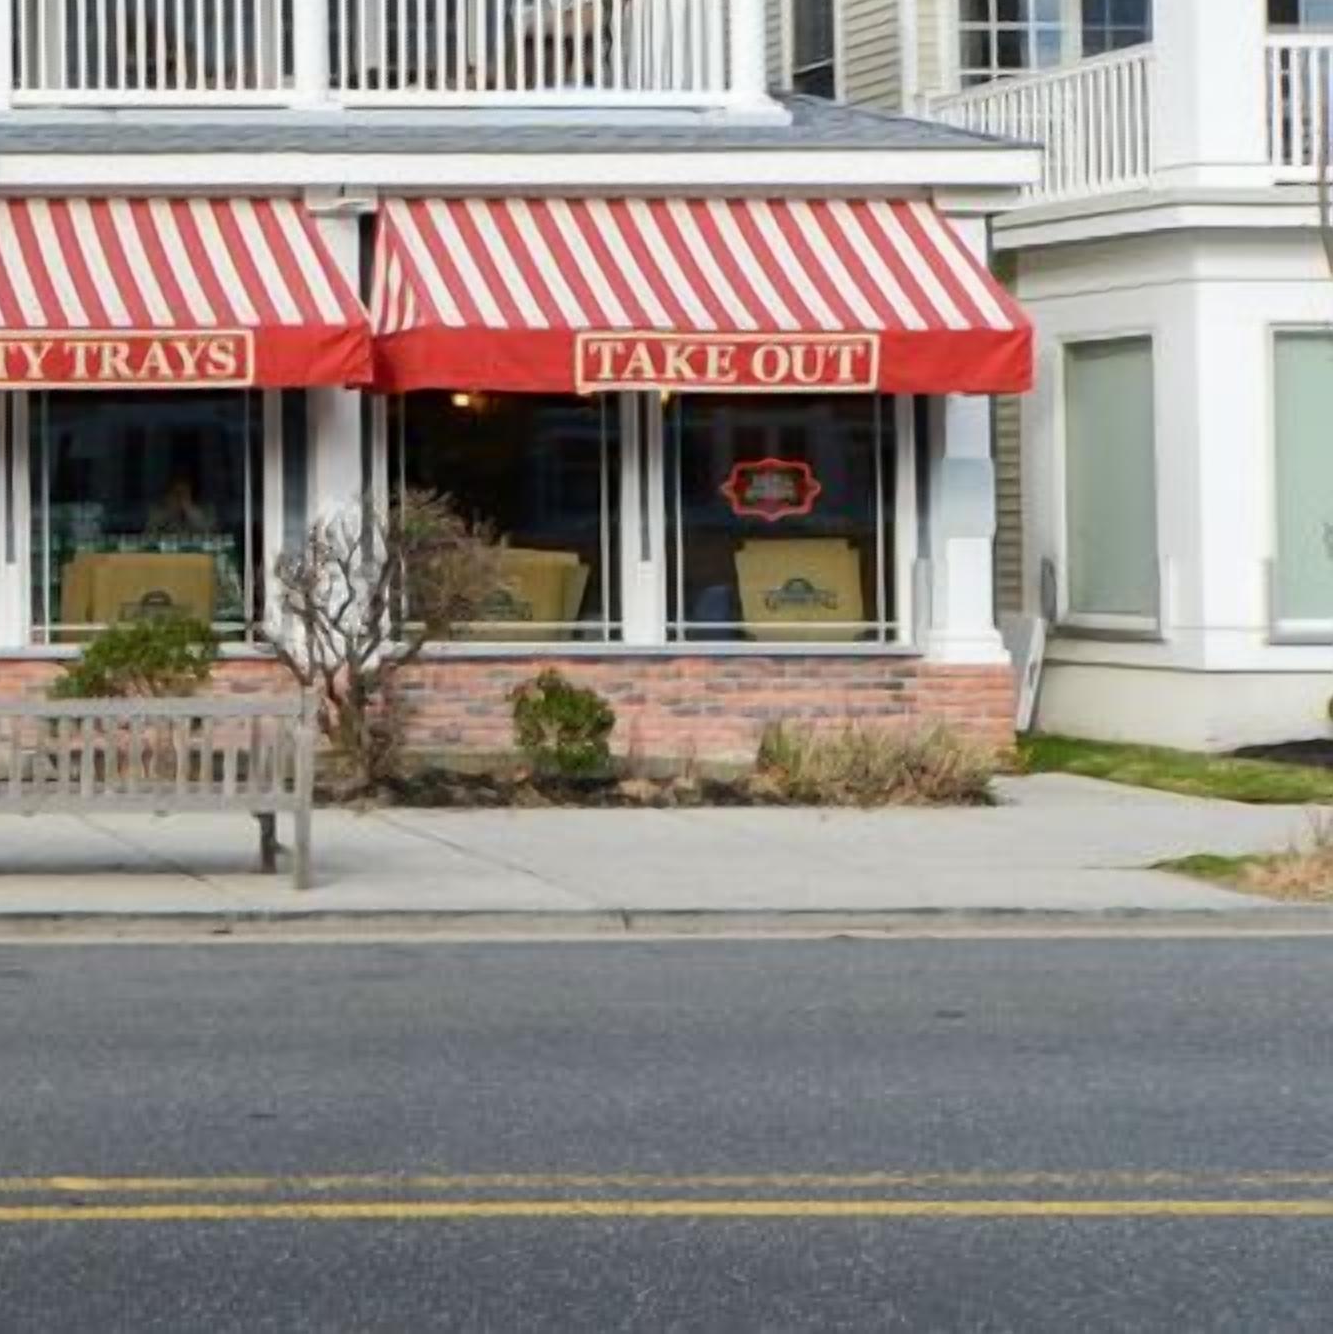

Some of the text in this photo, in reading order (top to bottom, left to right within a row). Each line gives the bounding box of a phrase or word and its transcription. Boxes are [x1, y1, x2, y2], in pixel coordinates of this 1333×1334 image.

[63, 338, 237, 379] TRAYS
[588, 340, 865, 383] TAKE OUT
